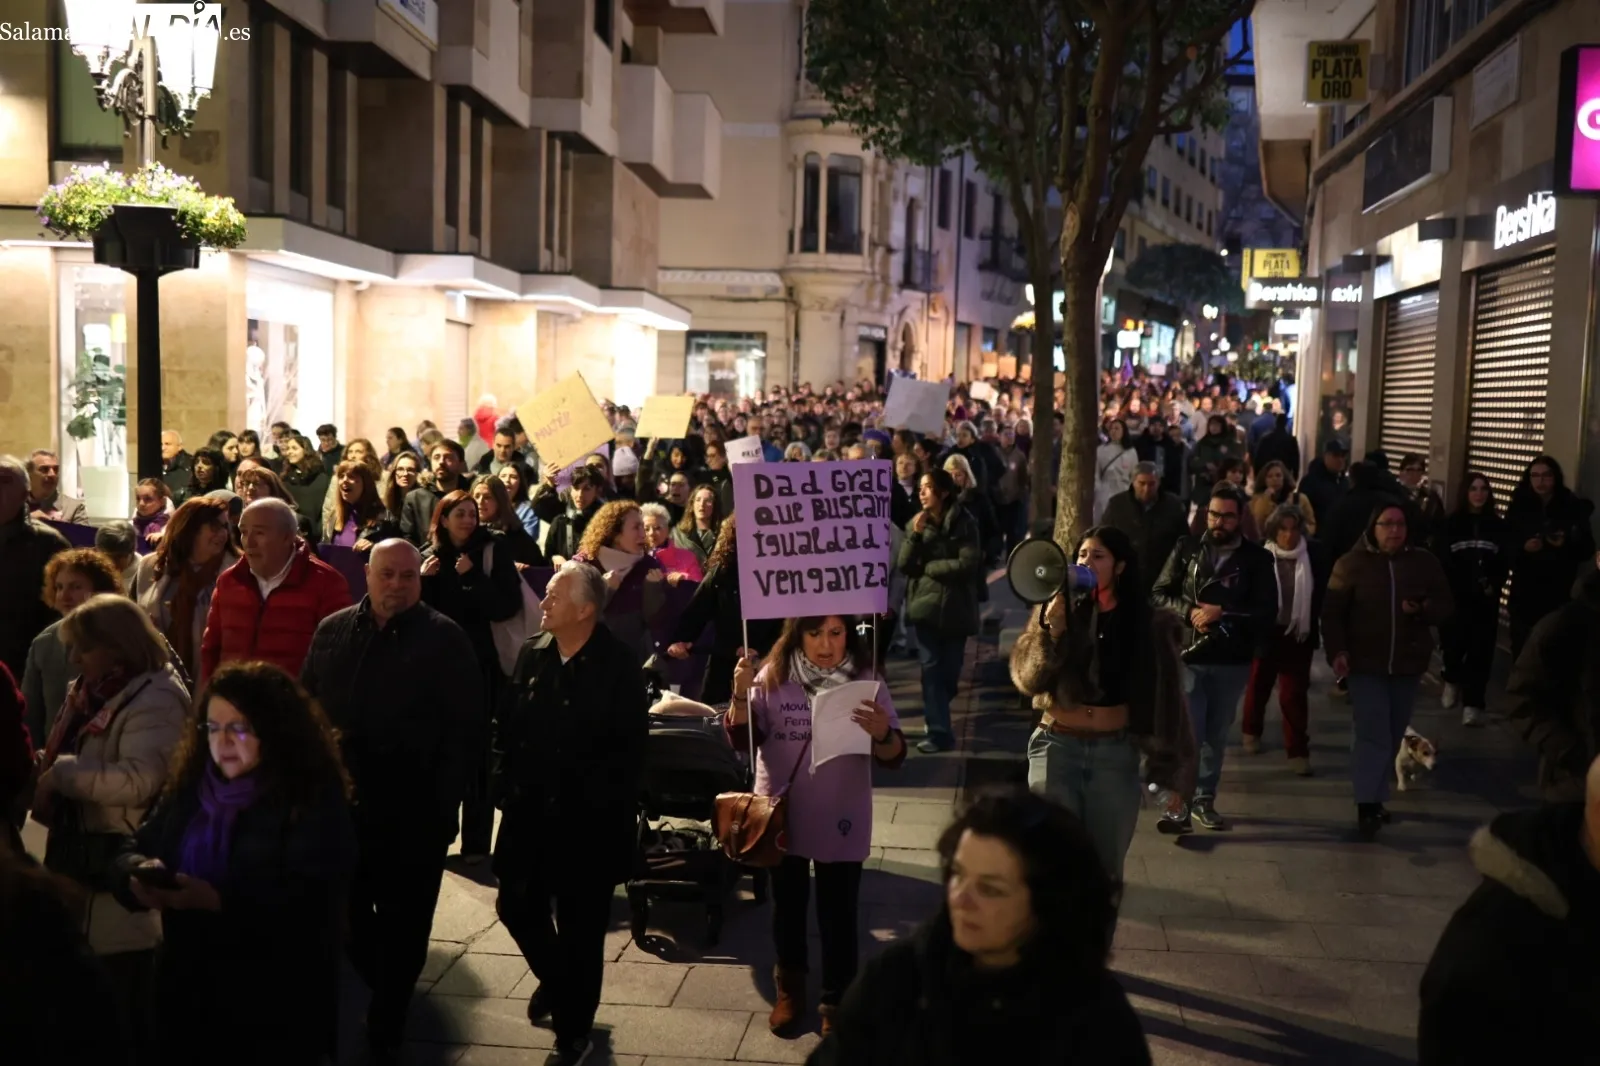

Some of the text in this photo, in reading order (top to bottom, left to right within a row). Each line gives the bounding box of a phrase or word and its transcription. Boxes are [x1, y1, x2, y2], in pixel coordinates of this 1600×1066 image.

[1311, 58, 1363, 80] PLATA
[1321, 80, 1352, 99] ORO
[1494, 191, 1556, 250] Bershka
[1263, 260, 1290, 270] PLATA
[754, 470, 823, 499] Dad
[752, 523, 880, 558] Igualdad
[774, 732, 787, 740] de
